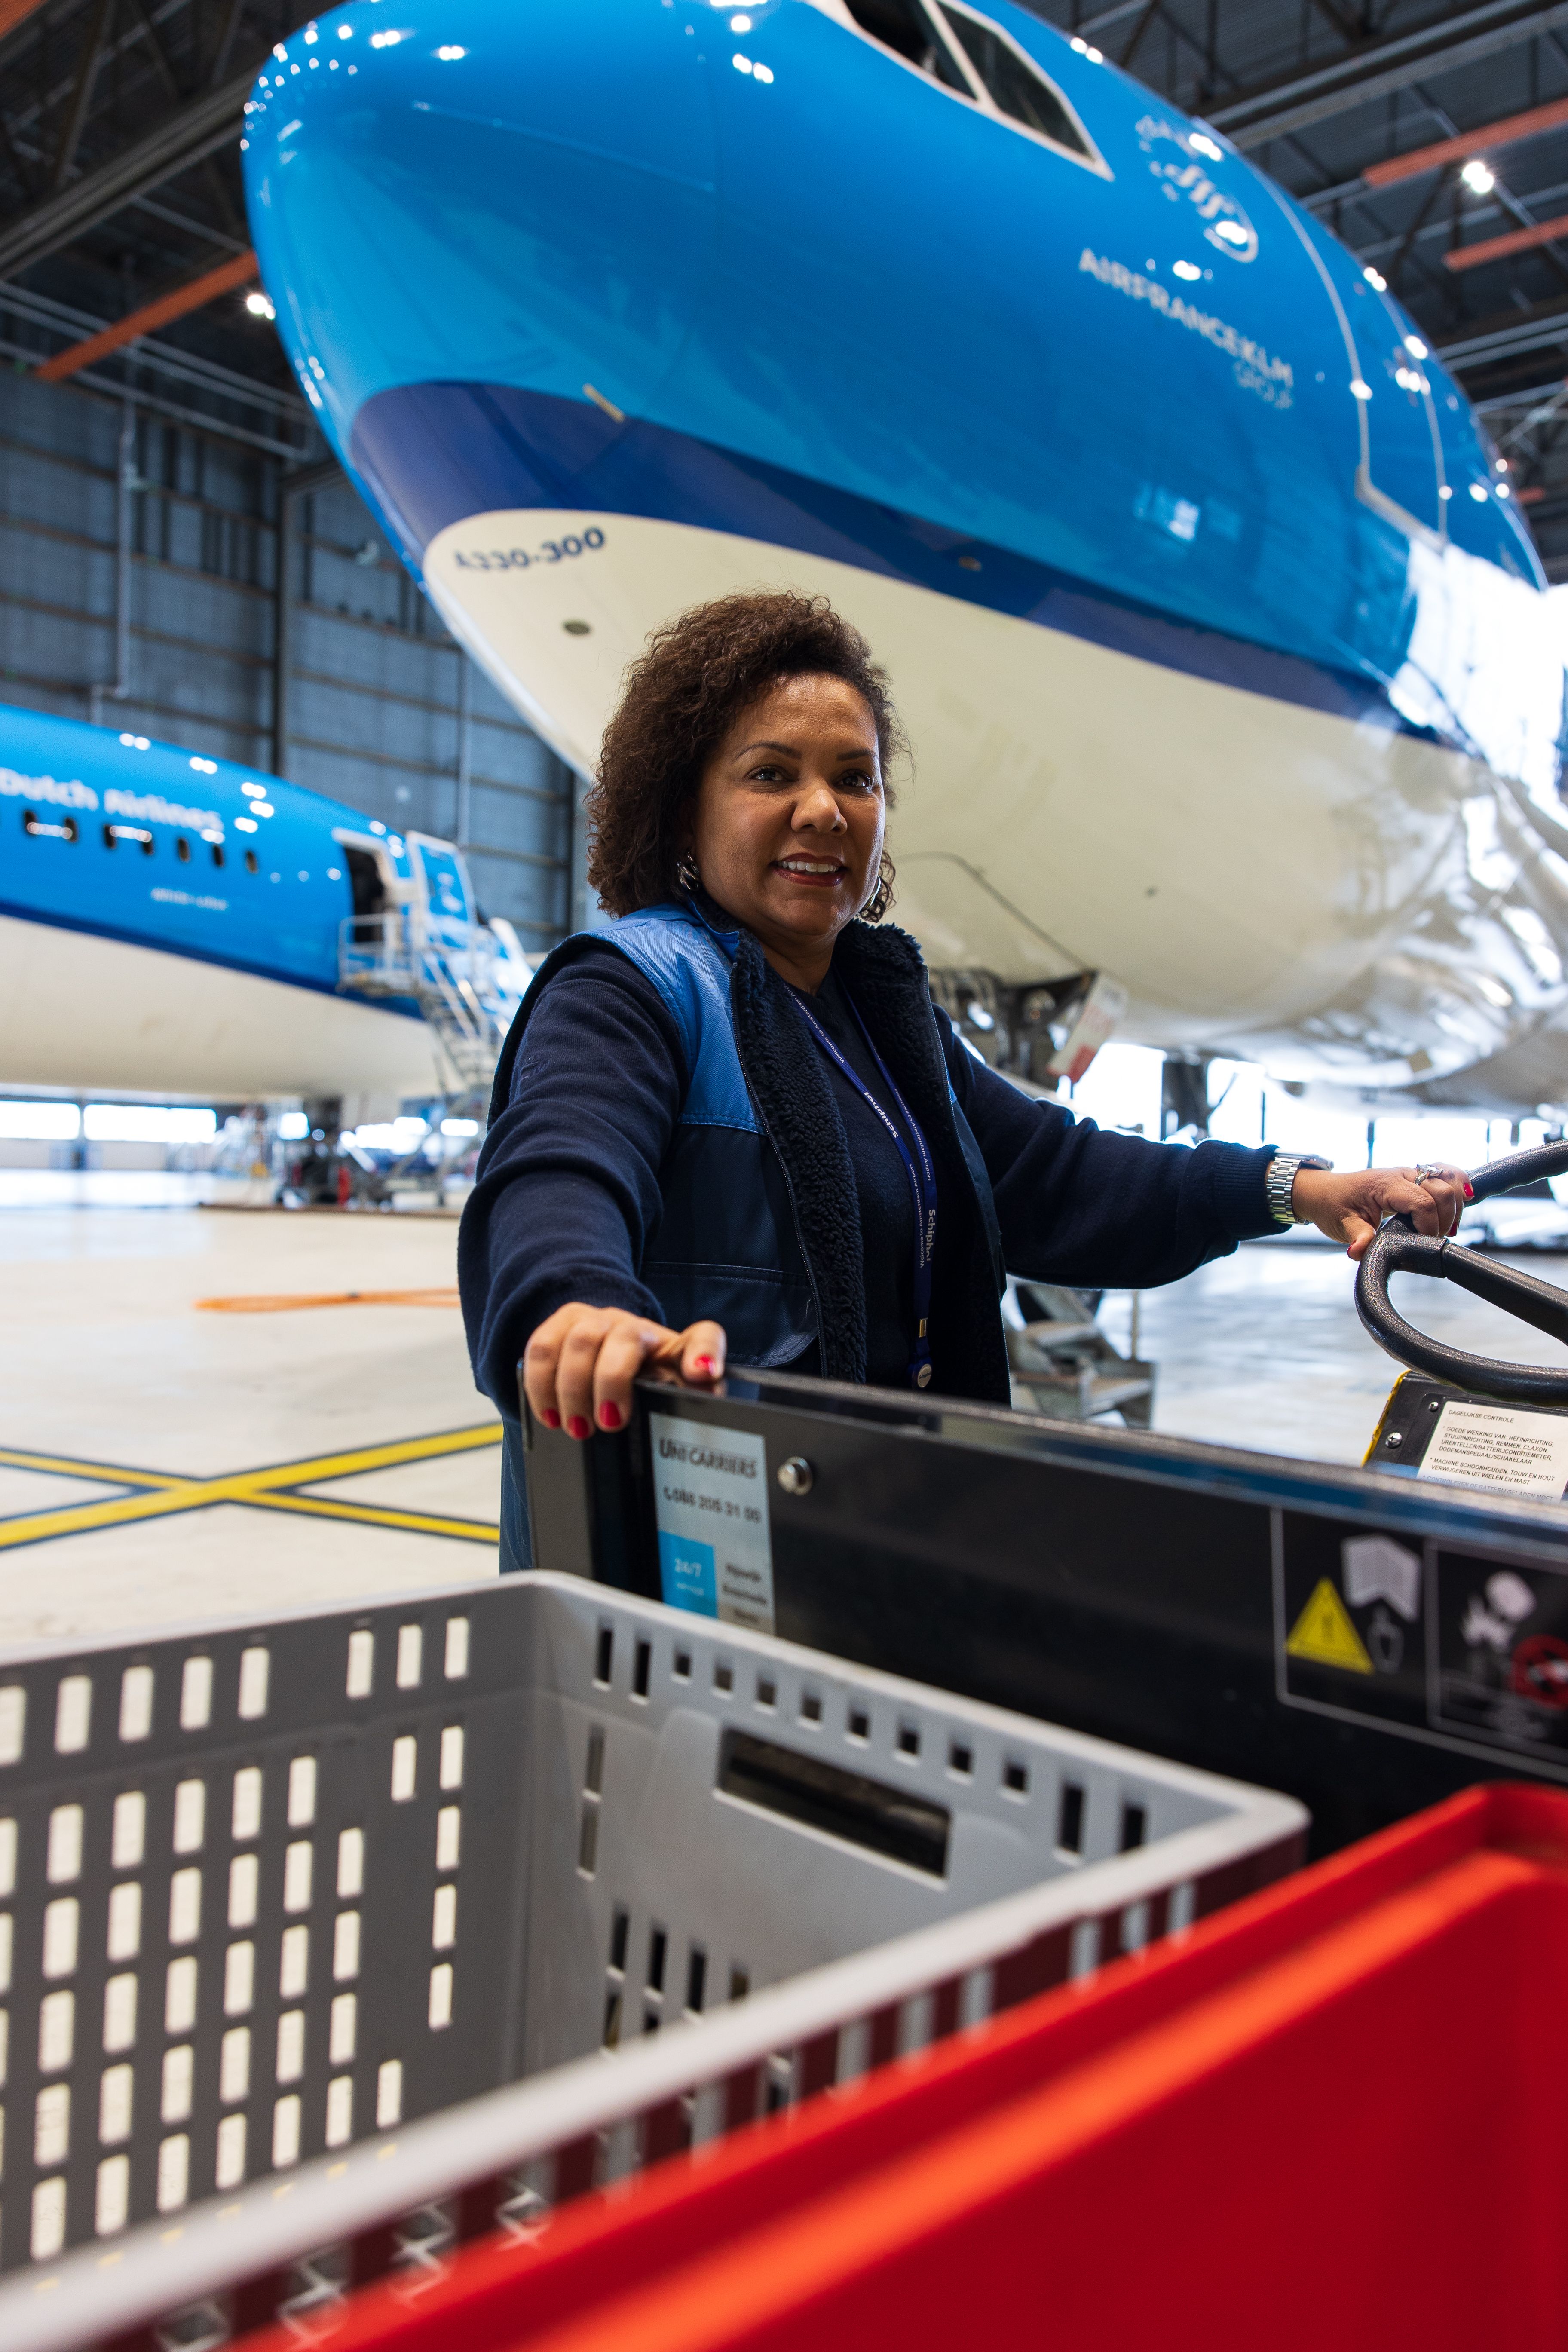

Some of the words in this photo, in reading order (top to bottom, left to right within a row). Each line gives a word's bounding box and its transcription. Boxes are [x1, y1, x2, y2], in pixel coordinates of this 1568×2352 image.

[795, 997, 820, 1029] Amsterdam
[824, 1037, 844, 1063] Welcome
[864, 1092, 899, 1138] Schiphol
[911, 1122, 926, 1157] Amsterdam
[909, 1163, 918, 1187] Airport
[1449, 1410, 1482, 1418] DAGELIJKSE
[1483, 1415, 1514, 1423] CONTROLE
[1441, 1440, 1552, 1461] URENTELLER/BATTERIJCONDITIEMETER,
[1444, 1433, 1494, 1445] STUURINRICHTING,
[1496, 1441, 1521, 1449] REMMEN,
[1523, 1445, 1548, 1453] CLAXON,
[1509, 1436, 1553, 1447] HEFINRICHTING,
[1439, 1446, 1532, 1464] DODEMANSPEDAAL/SCHAKELAAR
[1431, 1465, 1471, 1475] VERWIJDEREN
[1434, 1458, 1459, 1466] MACHINE
[1460, 1462, 1508, 1474] SCHOONHOUDEN,
